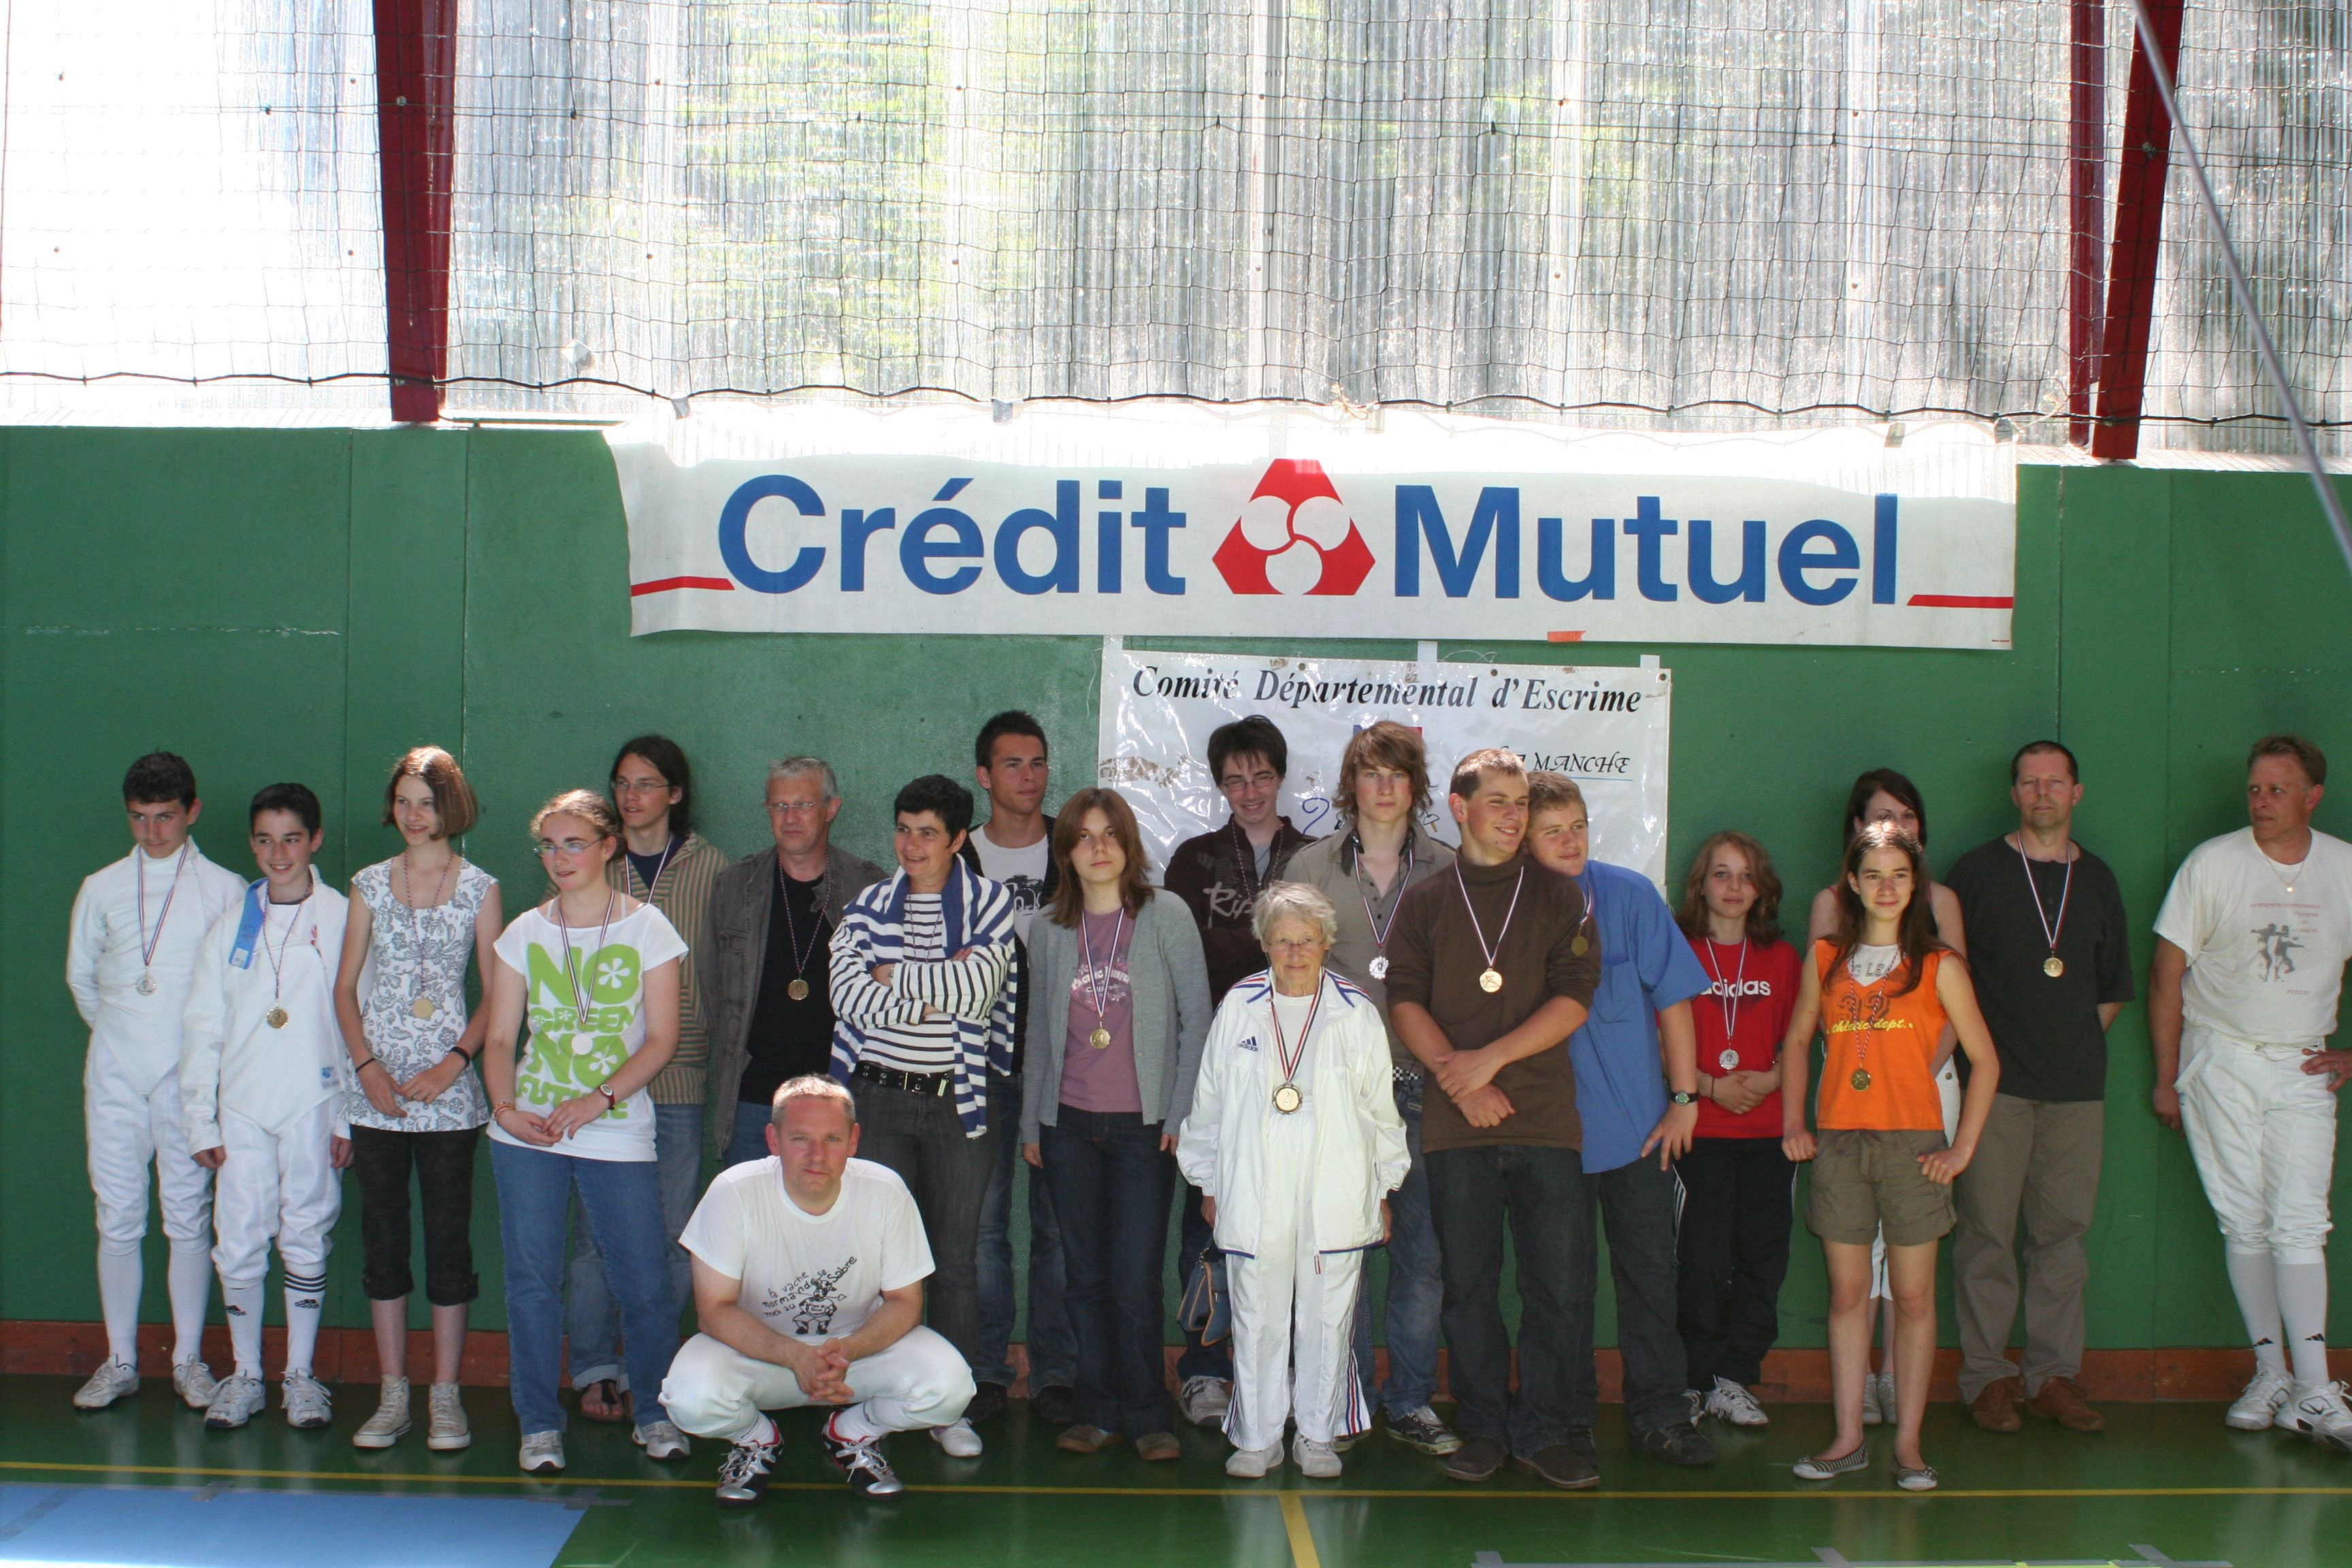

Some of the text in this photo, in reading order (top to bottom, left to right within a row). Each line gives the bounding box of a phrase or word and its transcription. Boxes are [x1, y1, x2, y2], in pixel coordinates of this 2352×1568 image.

[719, 474, 1898, 605] Crédit Mutuel
[1133, 666, 1642, 713] Comité Départemental d'Escrime
[1533, 751, 1631, 773] MANCHE
[526, 942, 641, 1007] NO
[781, 1271, 809, 1292] vache
